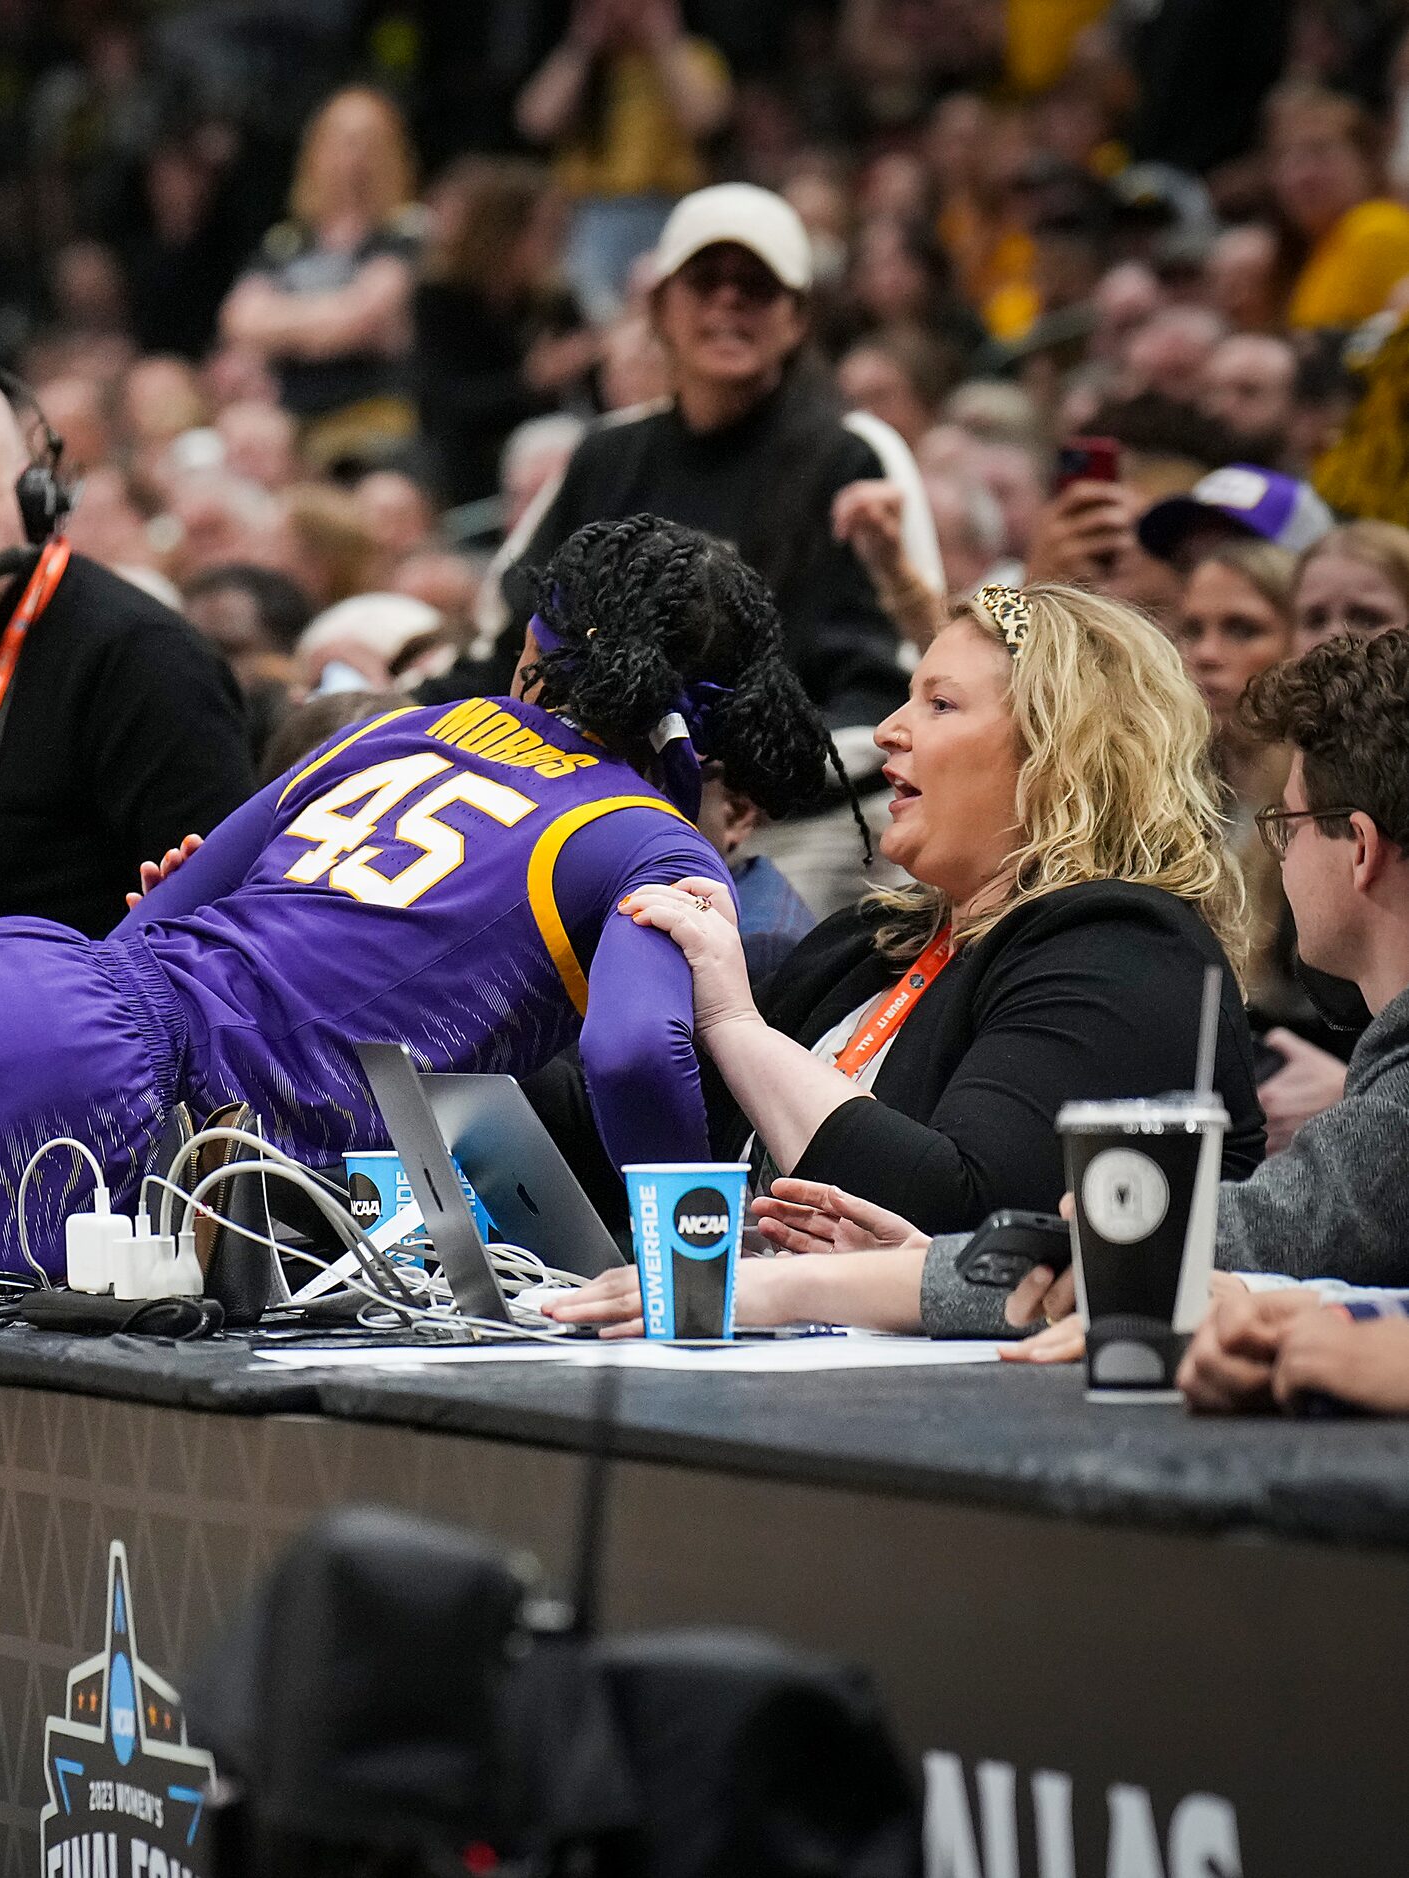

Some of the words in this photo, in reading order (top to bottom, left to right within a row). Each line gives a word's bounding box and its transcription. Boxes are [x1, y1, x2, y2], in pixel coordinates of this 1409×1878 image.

[283, 752, 540, 908] 45
[884, 991, 910, 1019] FOUR
[876, 1016, 891, 1030] IT
[855, 1032, 876, 1052] ALL
[677, 1214, 729, 1235] NCAA
[639, 1184, 666, 1335] POWERADE
